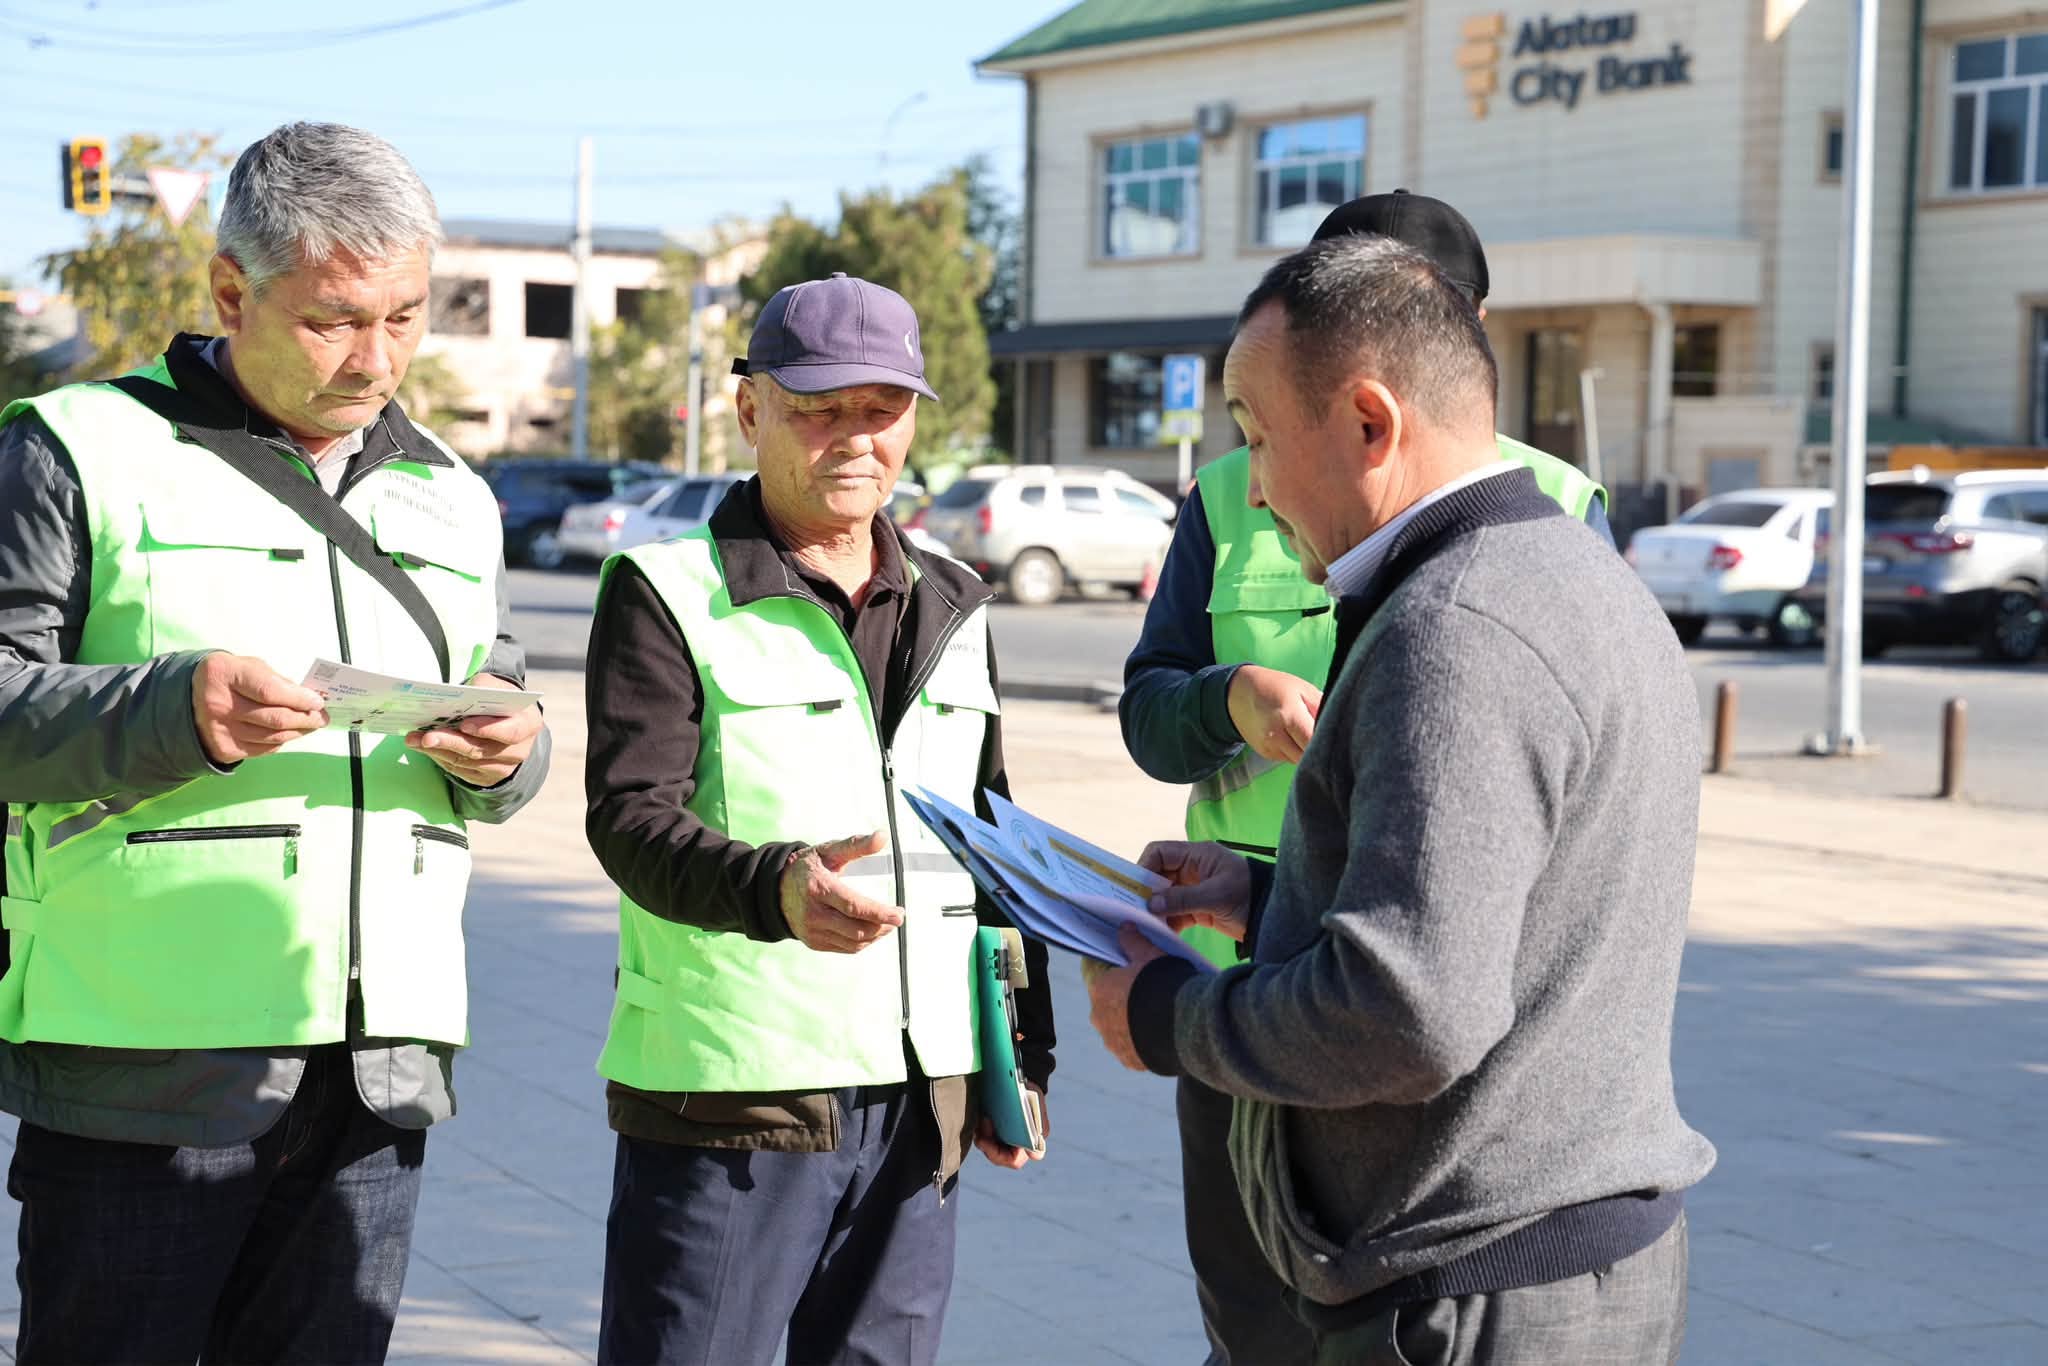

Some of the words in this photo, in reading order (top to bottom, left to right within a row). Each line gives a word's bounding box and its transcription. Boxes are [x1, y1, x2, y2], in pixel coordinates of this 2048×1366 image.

[1513, 12, 1636, 56] Alatau
[1511, 64, 1585, 110] City
[1598, 42, 1691, 93] Bank
[1173, 363, 1193, 404] P
